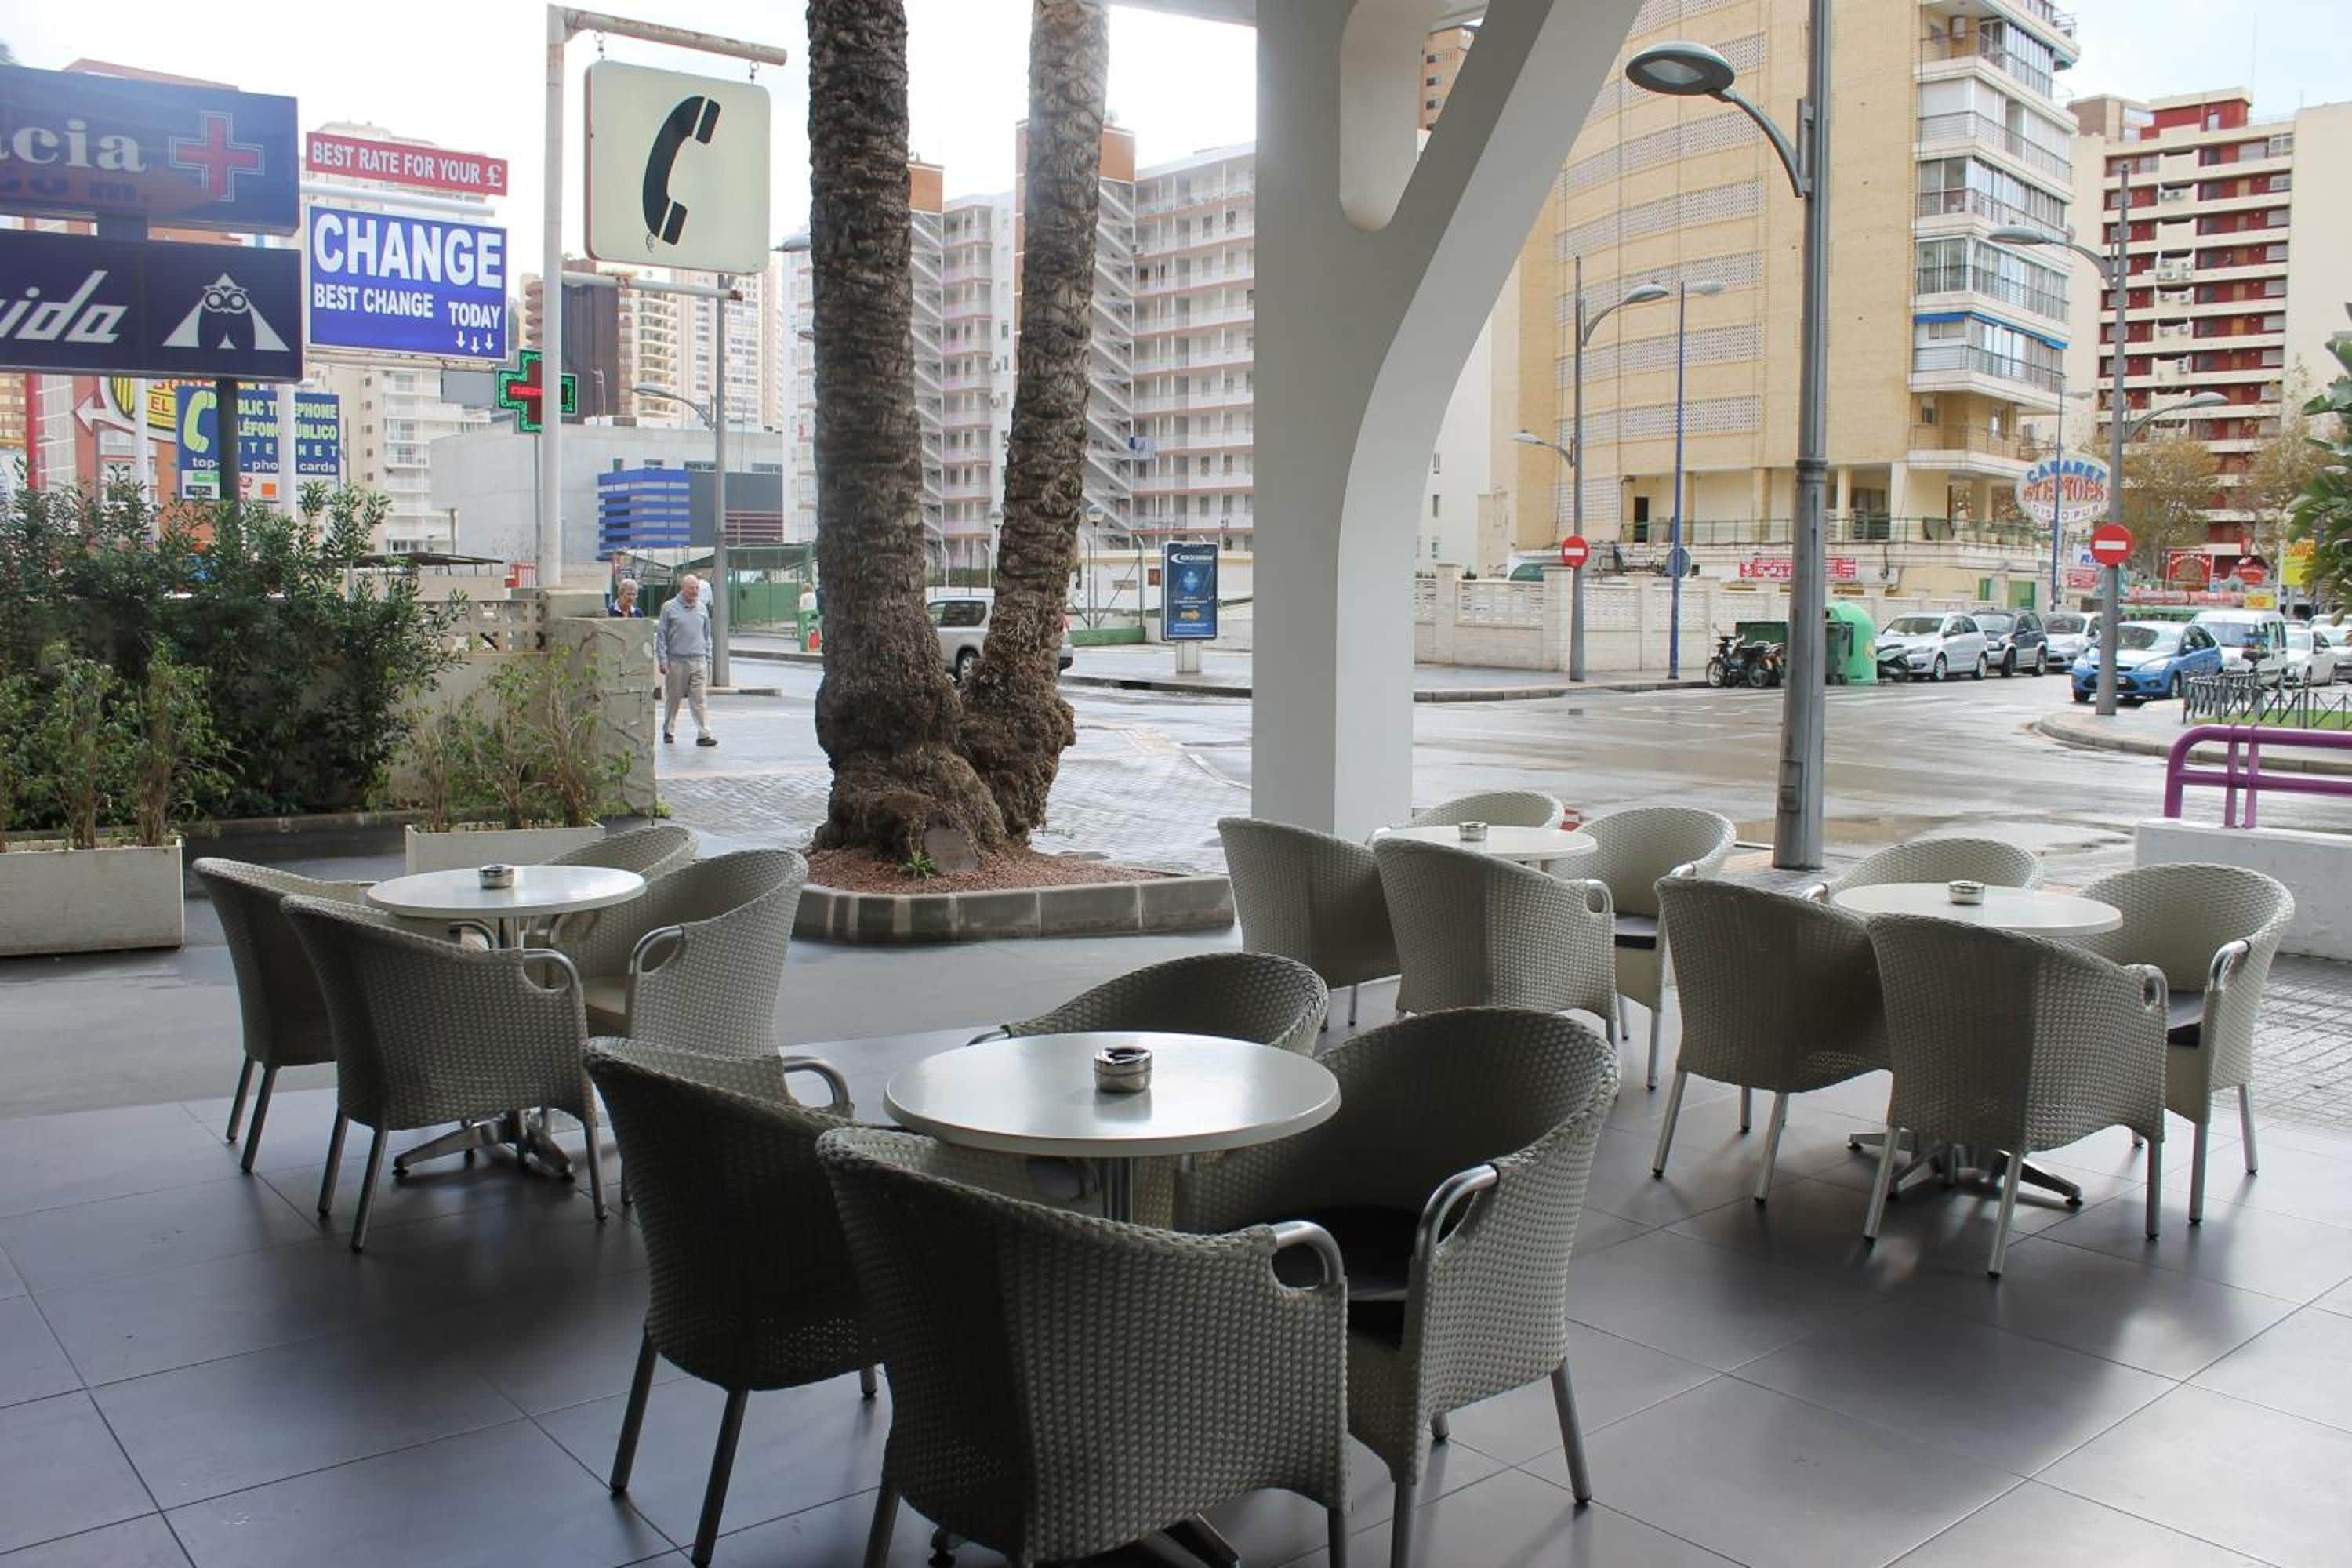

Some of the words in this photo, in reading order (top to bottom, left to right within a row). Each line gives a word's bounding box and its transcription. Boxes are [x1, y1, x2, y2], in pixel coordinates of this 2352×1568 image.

[0, 118, 147, 172] cia
[313, 141, 354, 167] BEST
[359, 148, 399, 175] RATE
[404, 155, 435, 180] FOR
[440, 159, 481, 185] YOUR
[486, 164, 503, 187] £
[314, 213, 503, 289] CHANGE
[0, 270, 129, 343] ida
[314, 283, 359, 310] BEST
[363, 288, 434, 318] CHANGE
[448, 301, 502, 329] TODAY
[150, 396, 170, 412] EL
[238, 398, 264, 416] BLIC
[295, 420, 337, 441] ÚBLICO
[252, 459, 278, 472] pho
[299, 461, 336, 472] cards
[2027, 460, 2107, 483] CABARET
